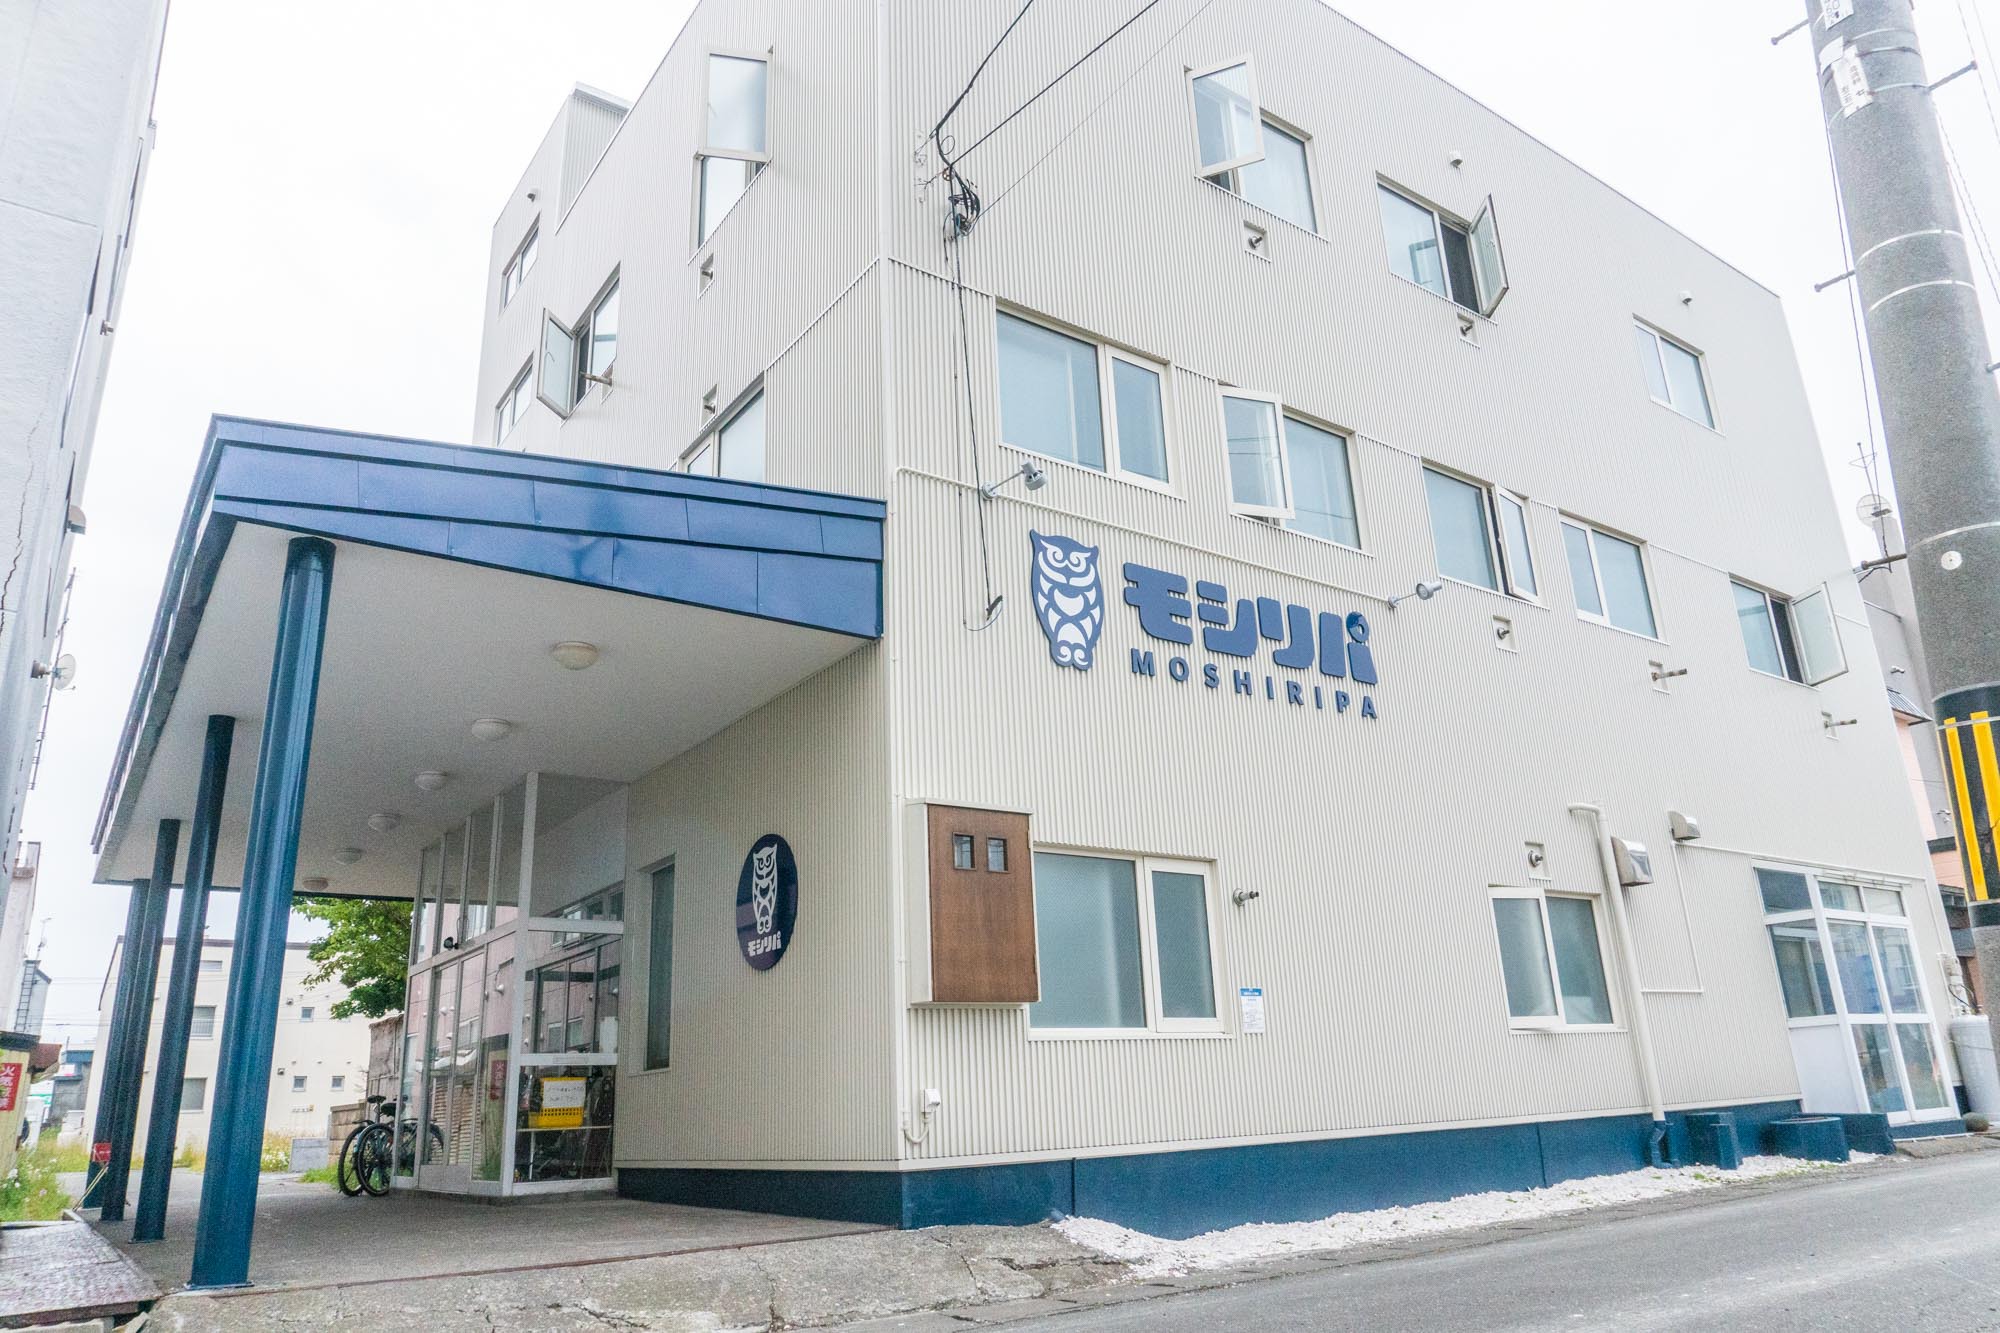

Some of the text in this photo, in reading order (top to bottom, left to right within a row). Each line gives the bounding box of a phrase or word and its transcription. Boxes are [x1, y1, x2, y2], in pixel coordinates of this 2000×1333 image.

[1123, 562, 1378, 685] モシリパ
[1130, 647, 1377, 719] MOSHIRIPA
[747, 930, 782, 957] モシリパ
